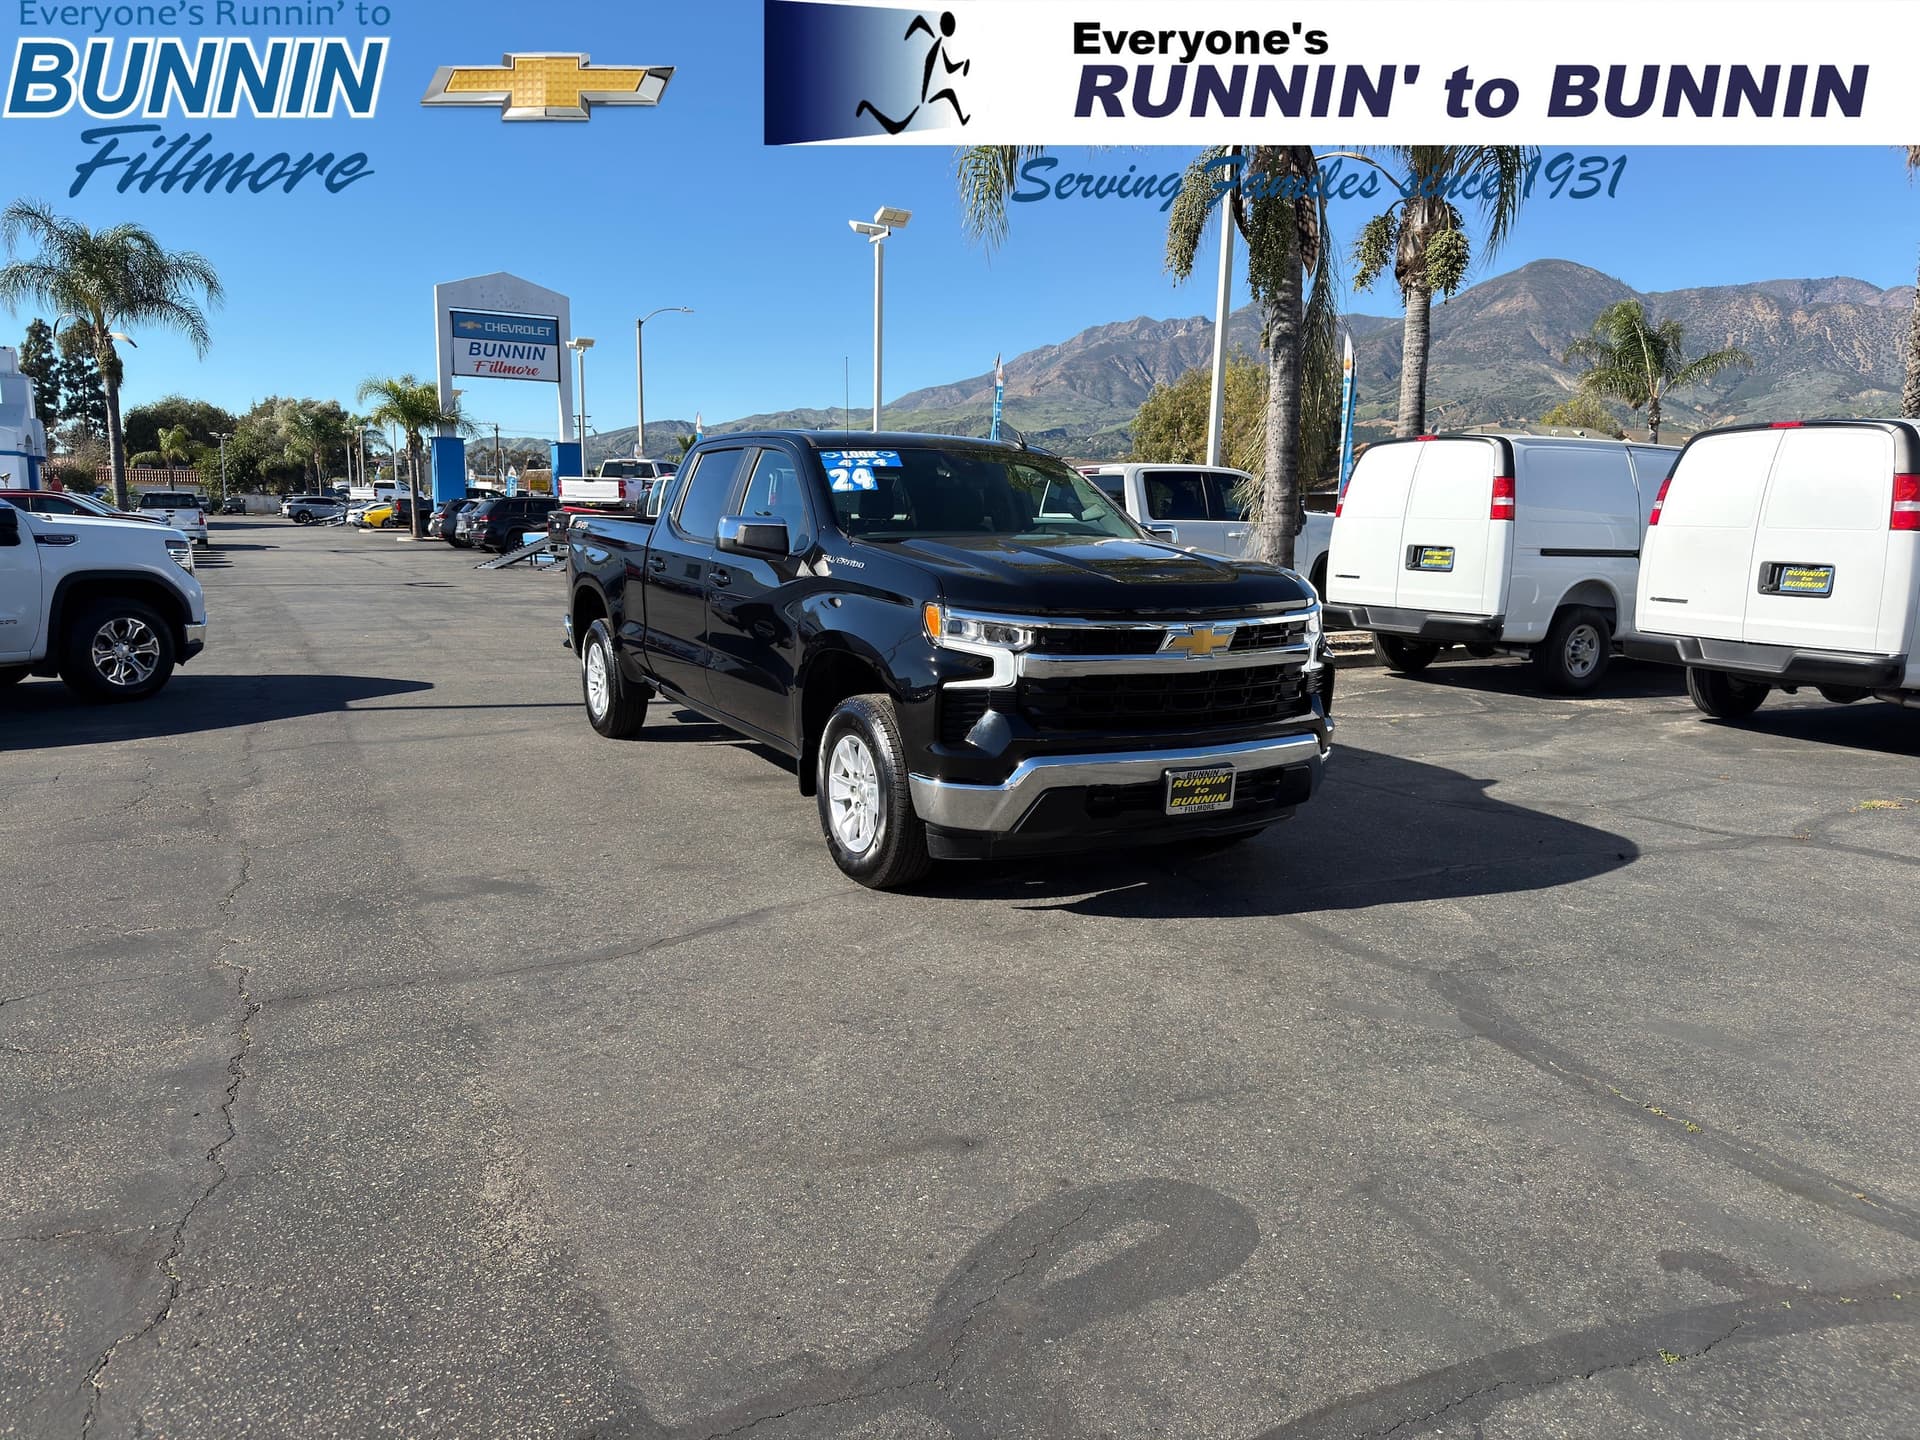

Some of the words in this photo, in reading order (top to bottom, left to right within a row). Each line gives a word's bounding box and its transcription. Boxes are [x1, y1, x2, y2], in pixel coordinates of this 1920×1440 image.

[485, 322, 551, 337] CHEVROLET
[469, 342, 546, 361] BUNNIN
[474, 361, 540, 376] Fillmore
[829, 469, 873, 490] 24
[822, 554, 865, 568] SILVERADO
[1171, 793, 1227, 806] BUNNIN
[1184, 804, 1215, 812] FILLMORE
